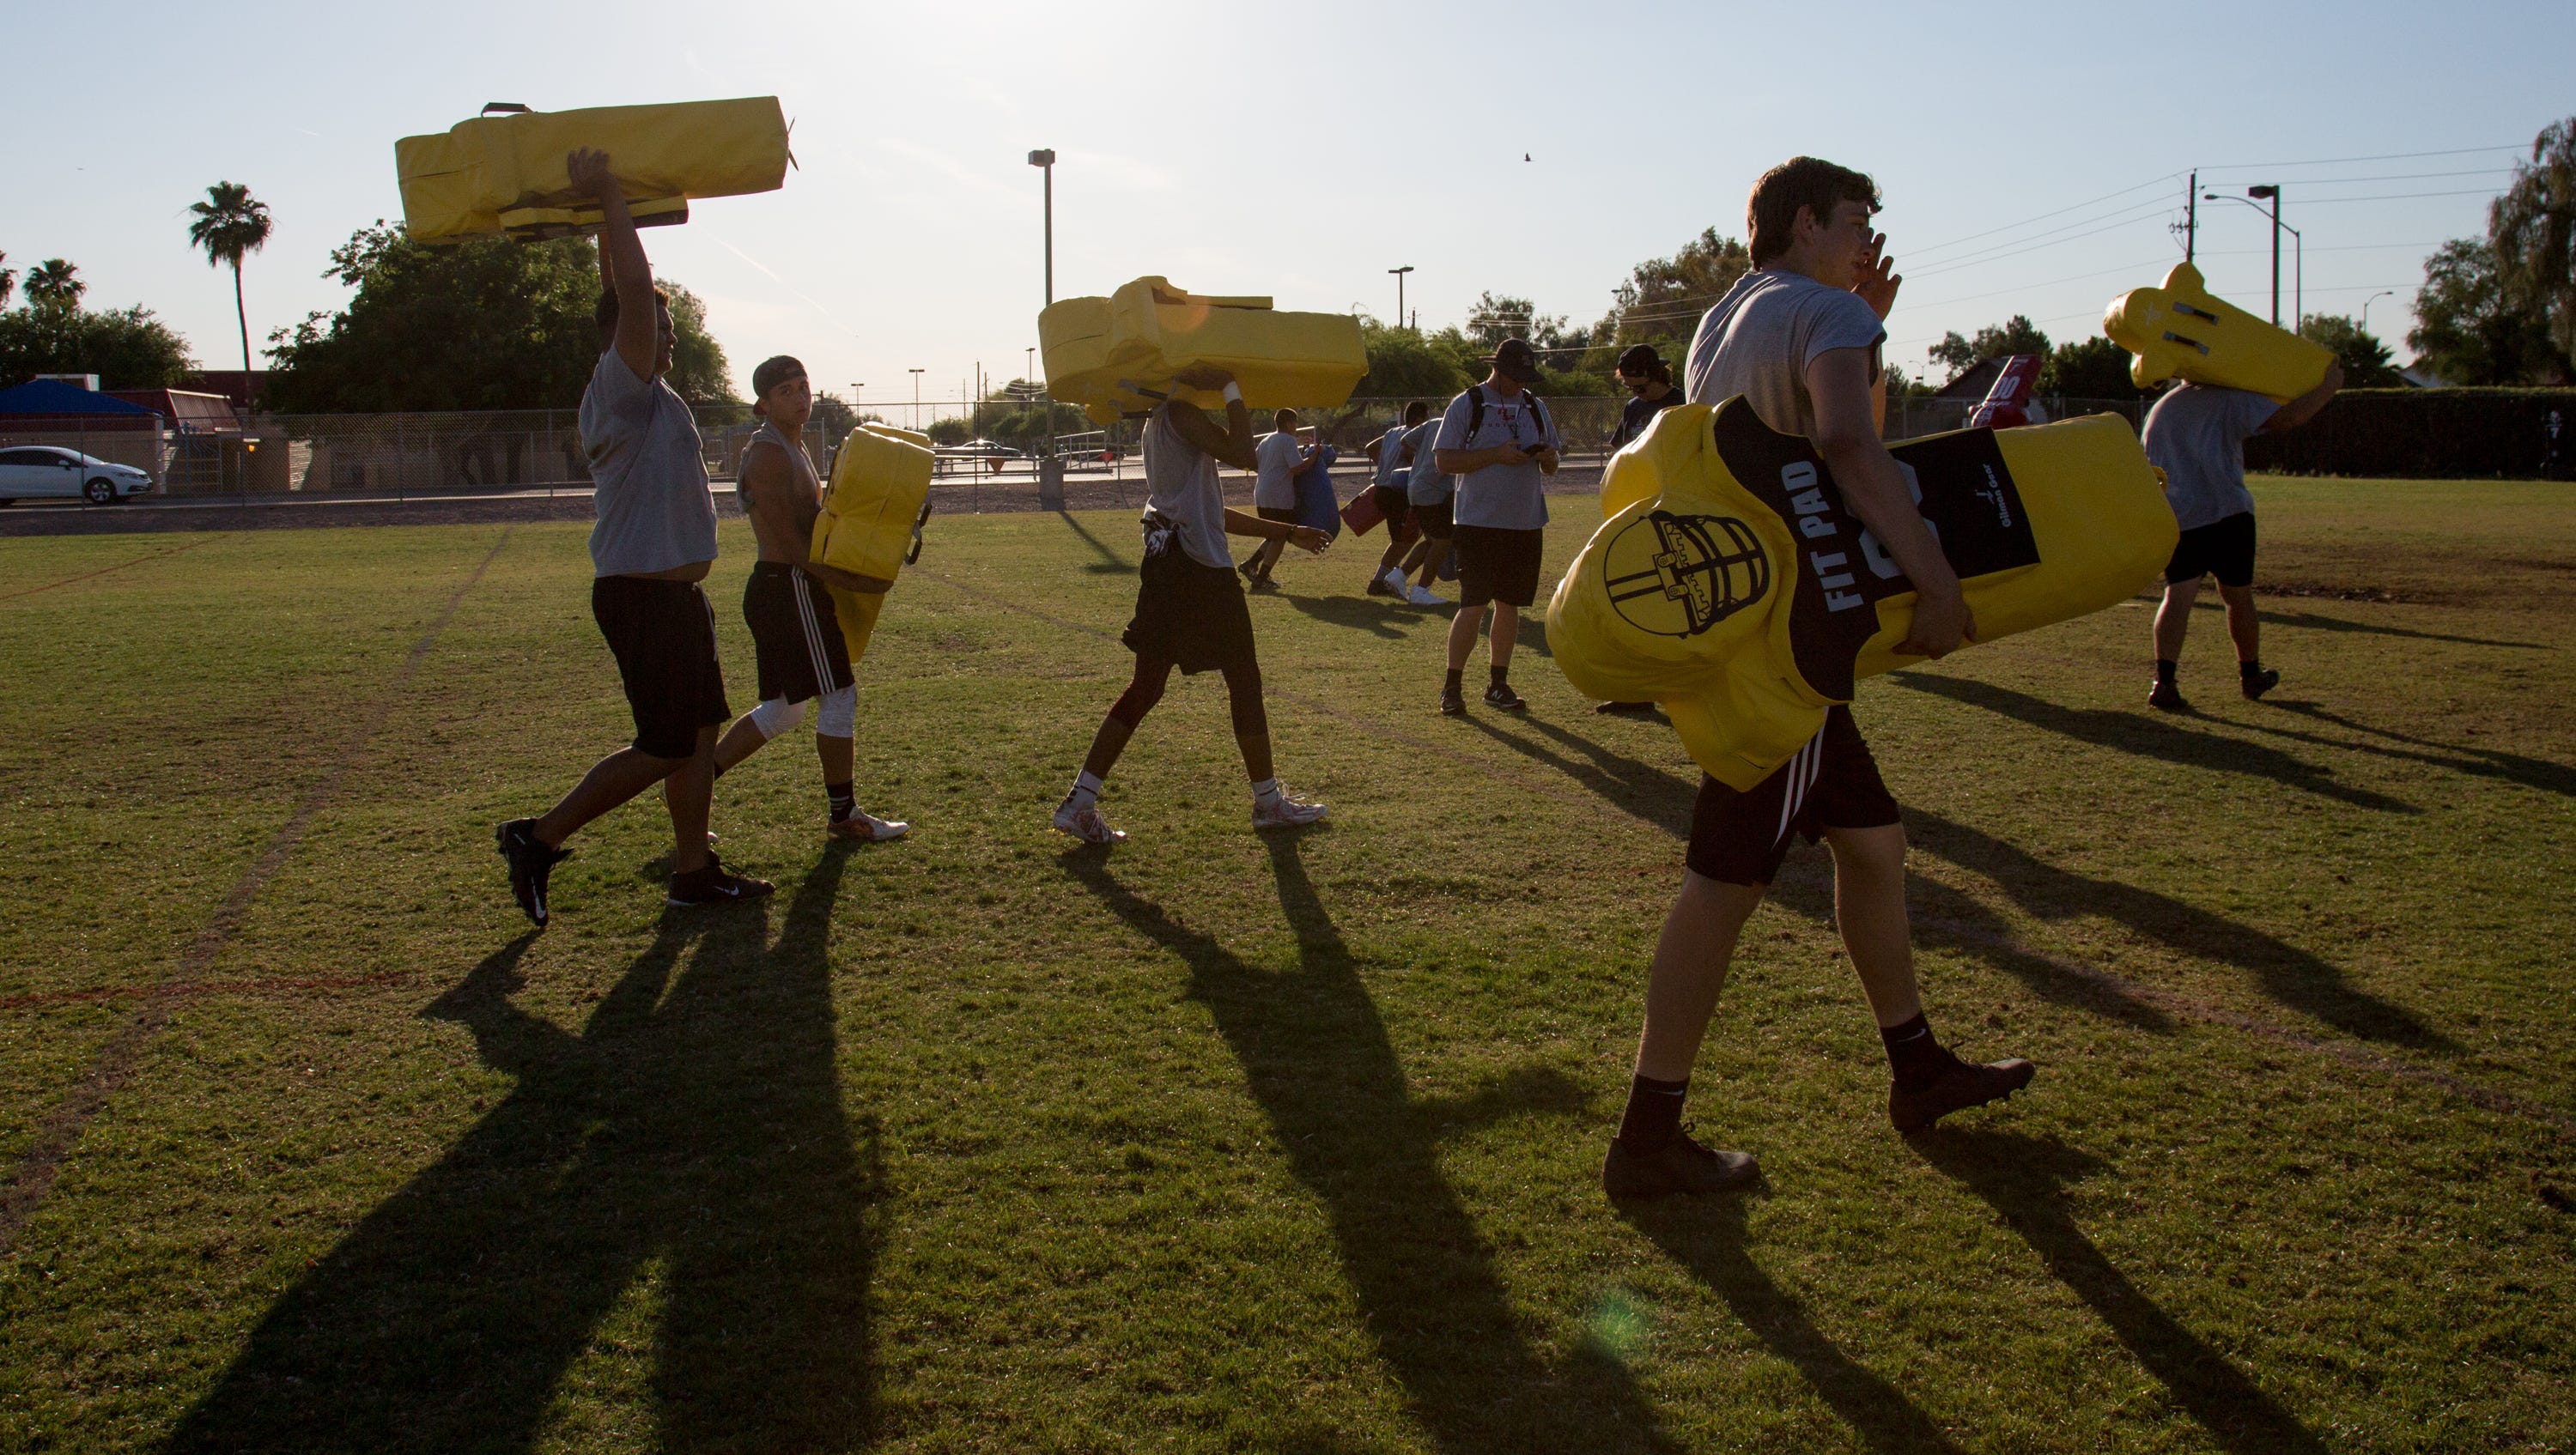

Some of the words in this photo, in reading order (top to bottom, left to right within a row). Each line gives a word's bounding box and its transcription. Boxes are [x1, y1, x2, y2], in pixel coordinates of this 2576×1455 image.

[1991, 376, 2020, 399] 00
[1983, 464, 1998, 488] Gear
[1781, 460, 1838, 539] PAD
[1995, 489, 2012, 528] Gilman
[1810, 551, 1864, 612] FIT
